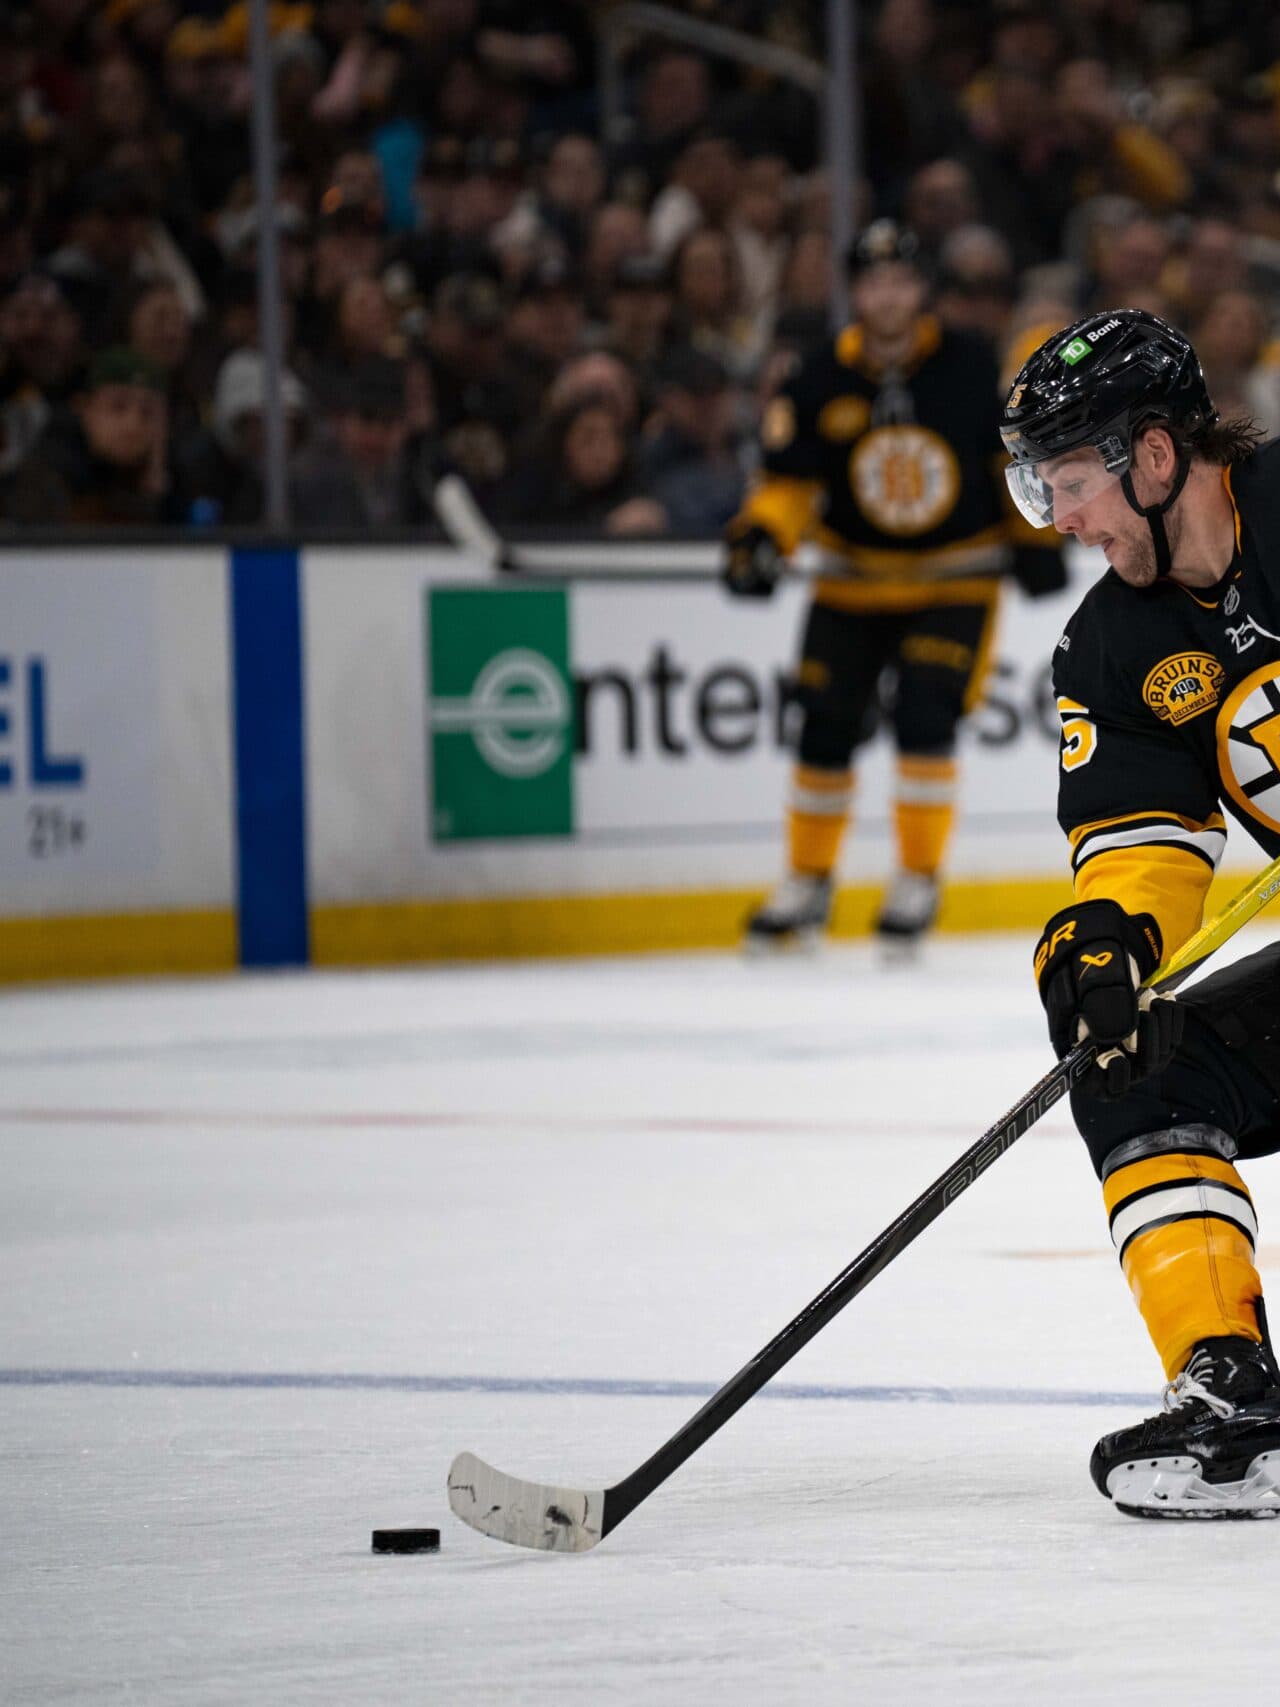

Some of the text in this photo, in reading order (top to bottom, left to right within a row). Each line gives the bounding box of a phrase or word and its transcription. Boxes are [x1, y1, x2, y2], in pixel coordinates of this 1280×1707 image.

[1063, 319, 1122, 359] TD Bank
[1150, 659, 1218, 705] BRUINS
[1173, 678, 1196, 696] 100
[1056, 695, 1098, 773] 5
